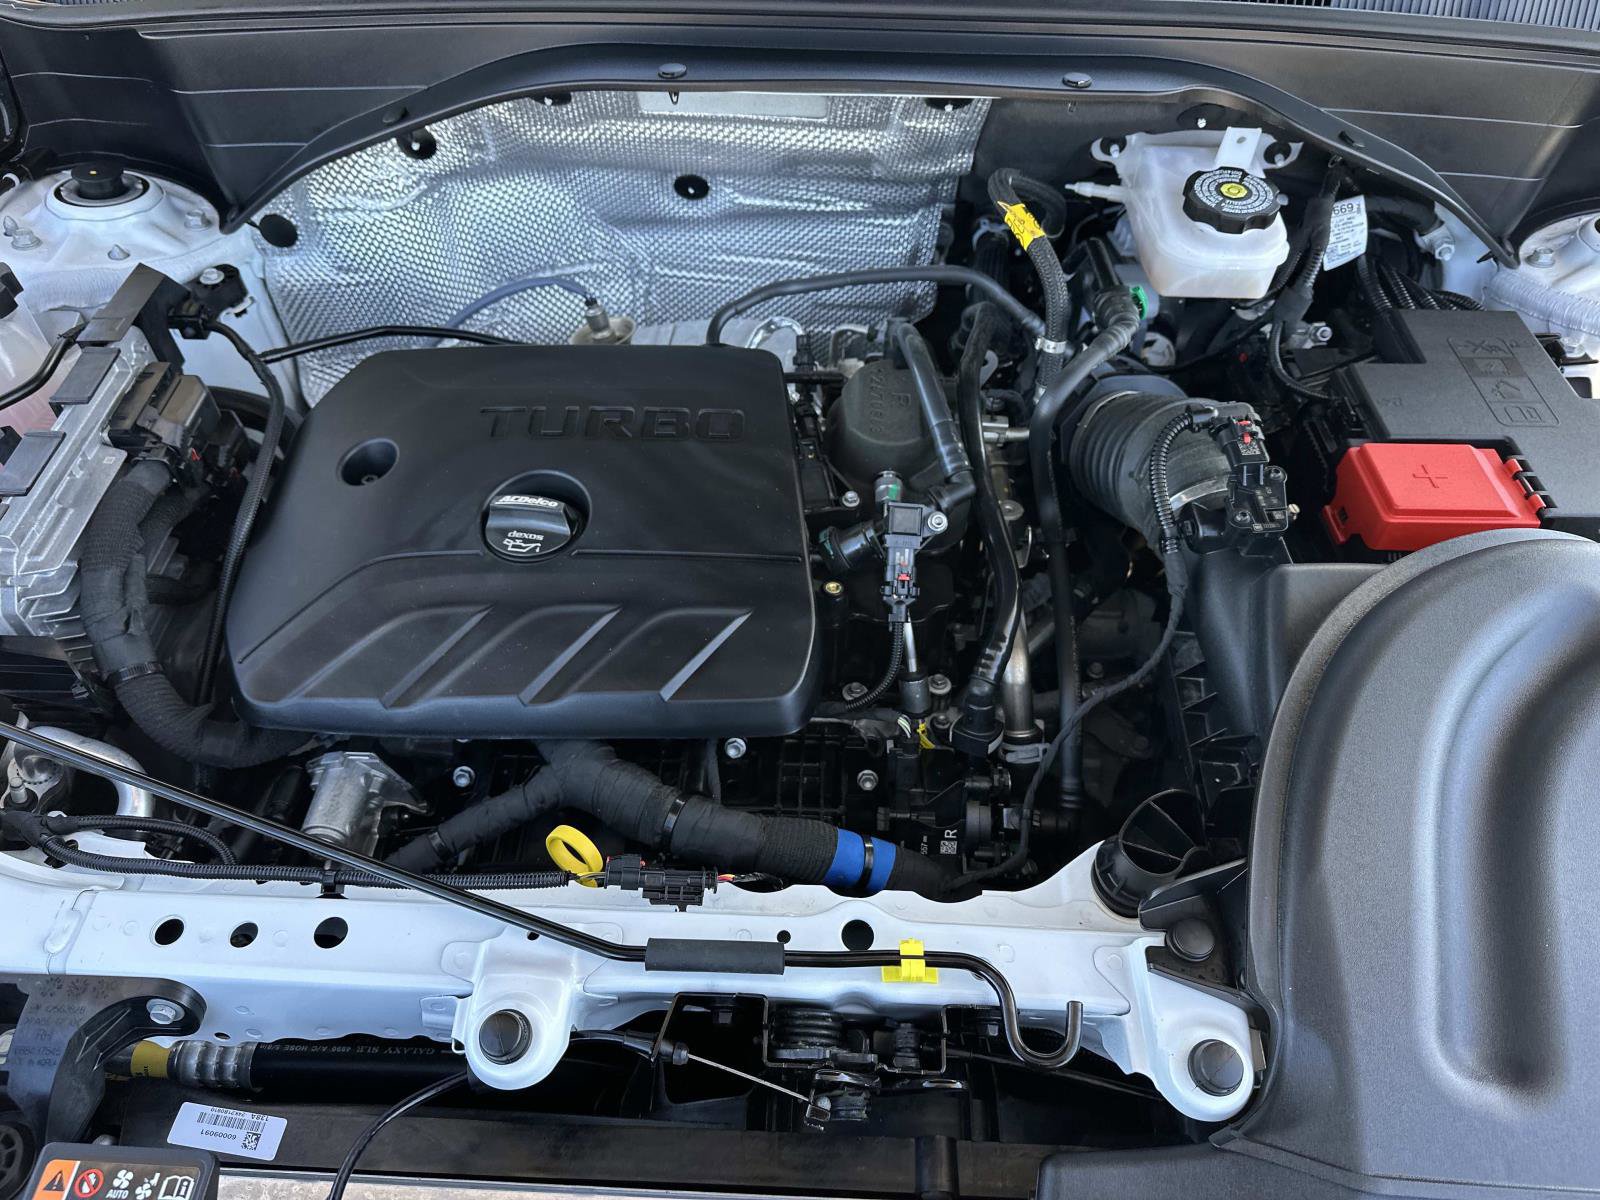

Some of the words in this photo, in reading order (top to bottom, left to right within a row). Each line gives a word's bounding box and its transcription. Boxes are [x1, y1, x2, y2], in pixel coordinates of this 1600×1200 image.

[480, 405, 745, 440] TURBO
[496, 495, 559, 507] ACDelco
[507, 530, 545, 541] dexos
[944, 829, 958, 839] R
[283, 1044, 308, 1052] HOSE
[105, 1189, 130, 1200] AUTO
